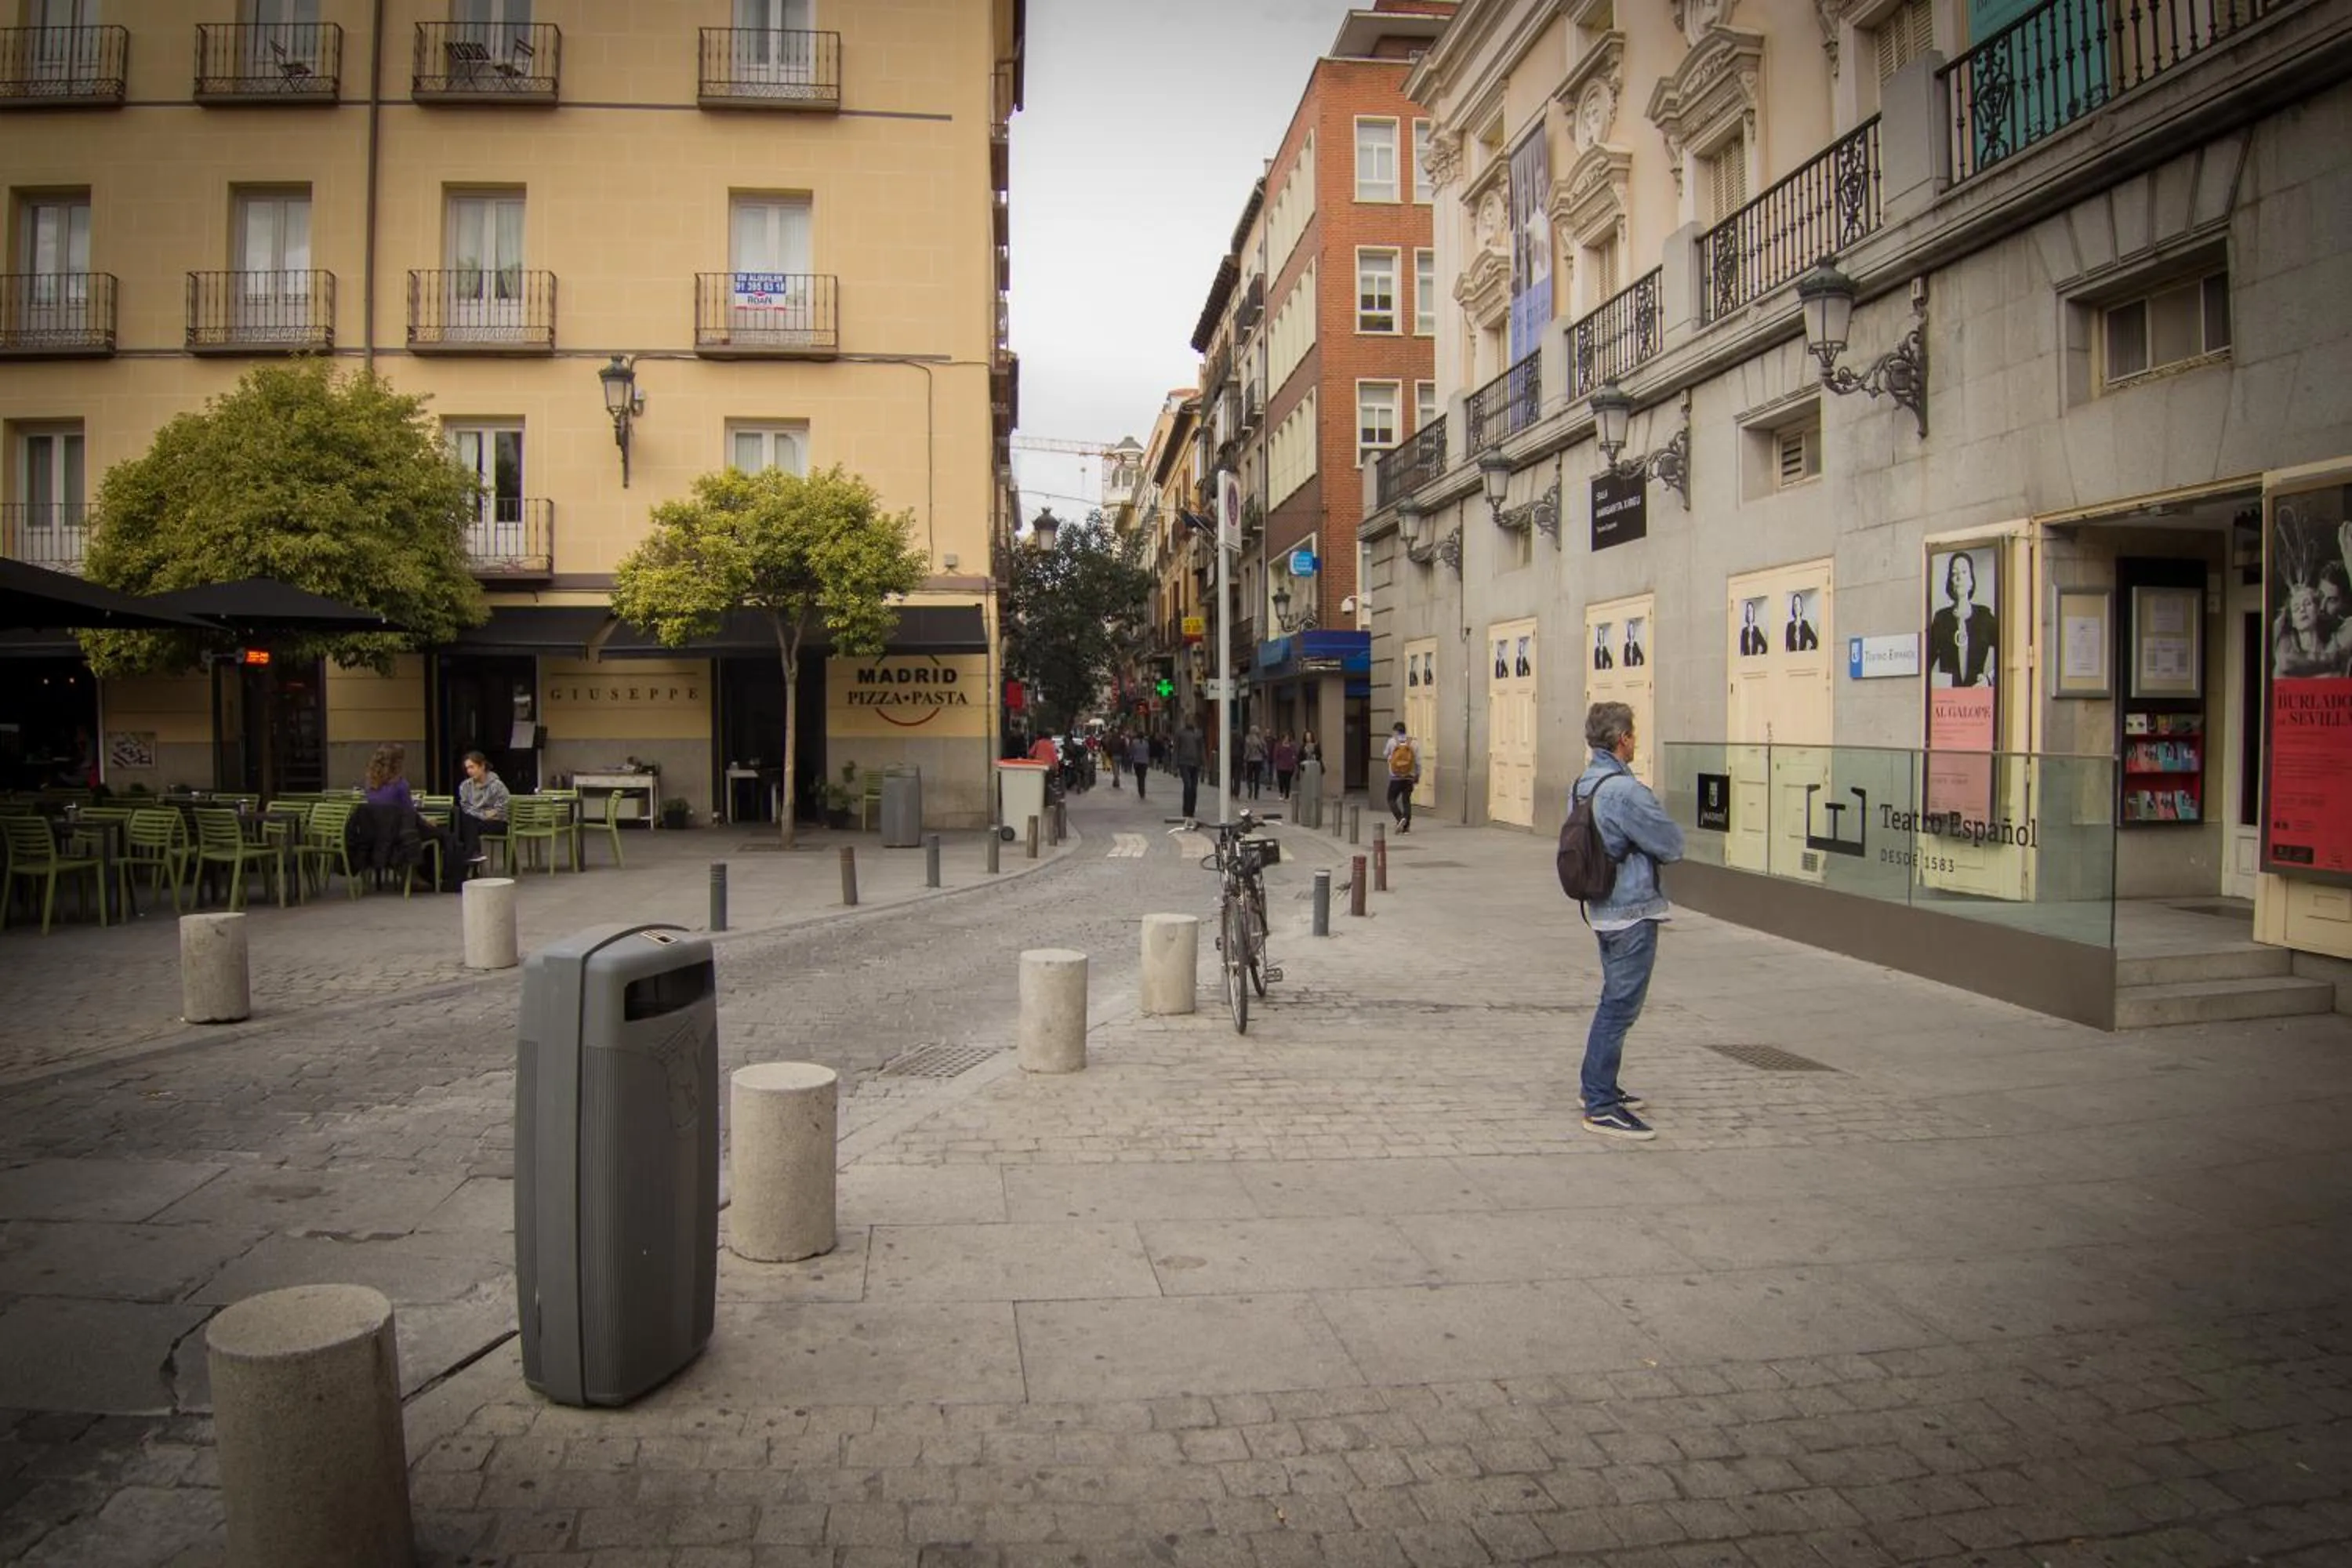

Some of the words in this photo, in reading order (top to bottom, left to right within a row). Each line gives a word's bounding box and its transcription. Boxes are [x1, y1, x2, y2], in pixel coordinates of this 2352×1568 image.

[858, 668, 957, 684] MADRID
[550, 688, 699, 701] GIUSEPPE
[1880, 804, 1944, 836] Teatro
[1948, 810, 2038, 848] Español
[1881, 848, 1919, 866] DESDE
[1925, 856, 1955, 873] 1583
